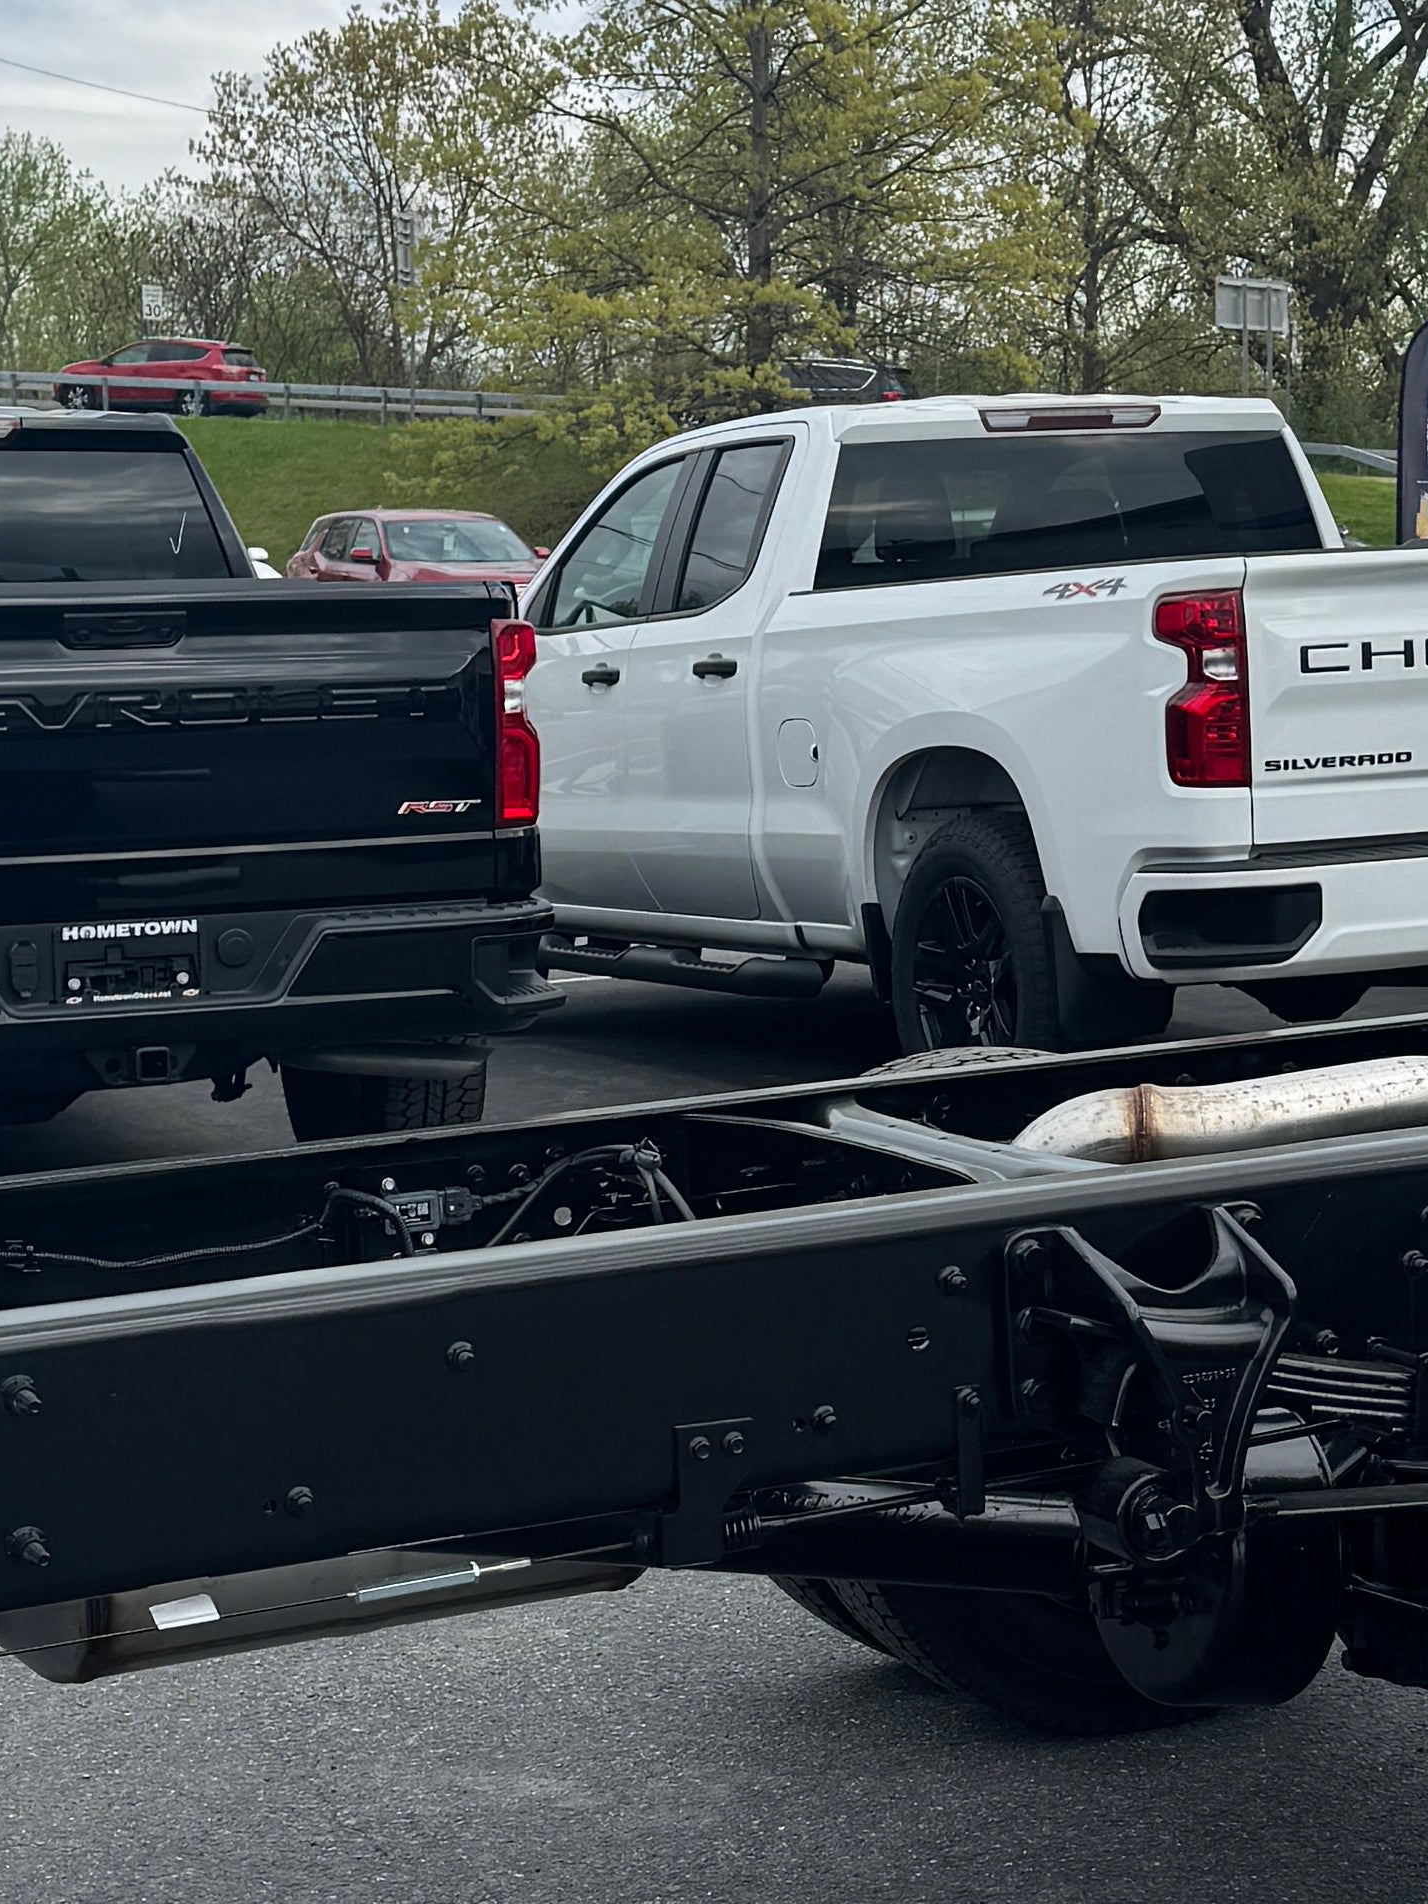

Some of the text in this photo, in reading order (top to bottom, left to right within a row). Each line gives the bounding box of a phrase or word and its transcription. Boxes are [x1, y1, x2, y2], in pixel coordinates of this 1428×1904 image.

[1264, 751, 1413, 772] SILVERADO
[397, 799, 482, 815] RST
[61, 918, 198, 941] HOMETOWN
